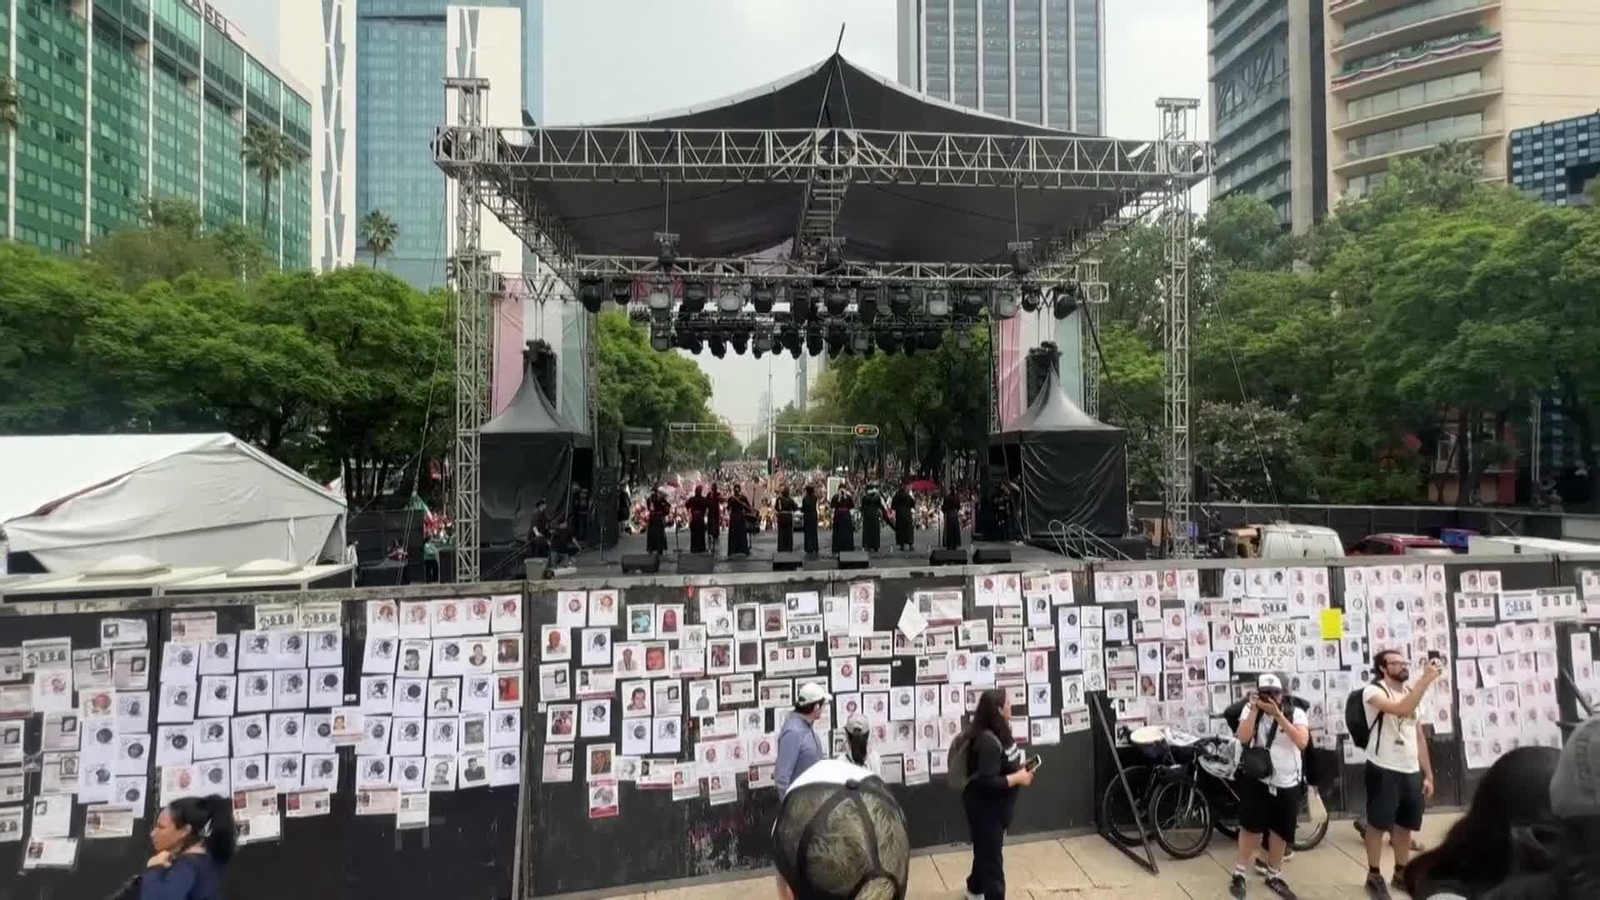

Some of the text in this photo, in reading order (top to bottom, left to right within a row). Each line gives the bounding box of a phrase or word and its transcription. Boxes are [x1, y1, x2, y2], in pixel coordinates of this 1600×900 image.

[1234, 618, 1296, 635] UNA MADRE NO
[1269, 633, 1297, 646] BUSCAR
[1233, 645, 1295, 659] RESTOS DE SUS
[1248, 657, 1283, 669] HIJXS
